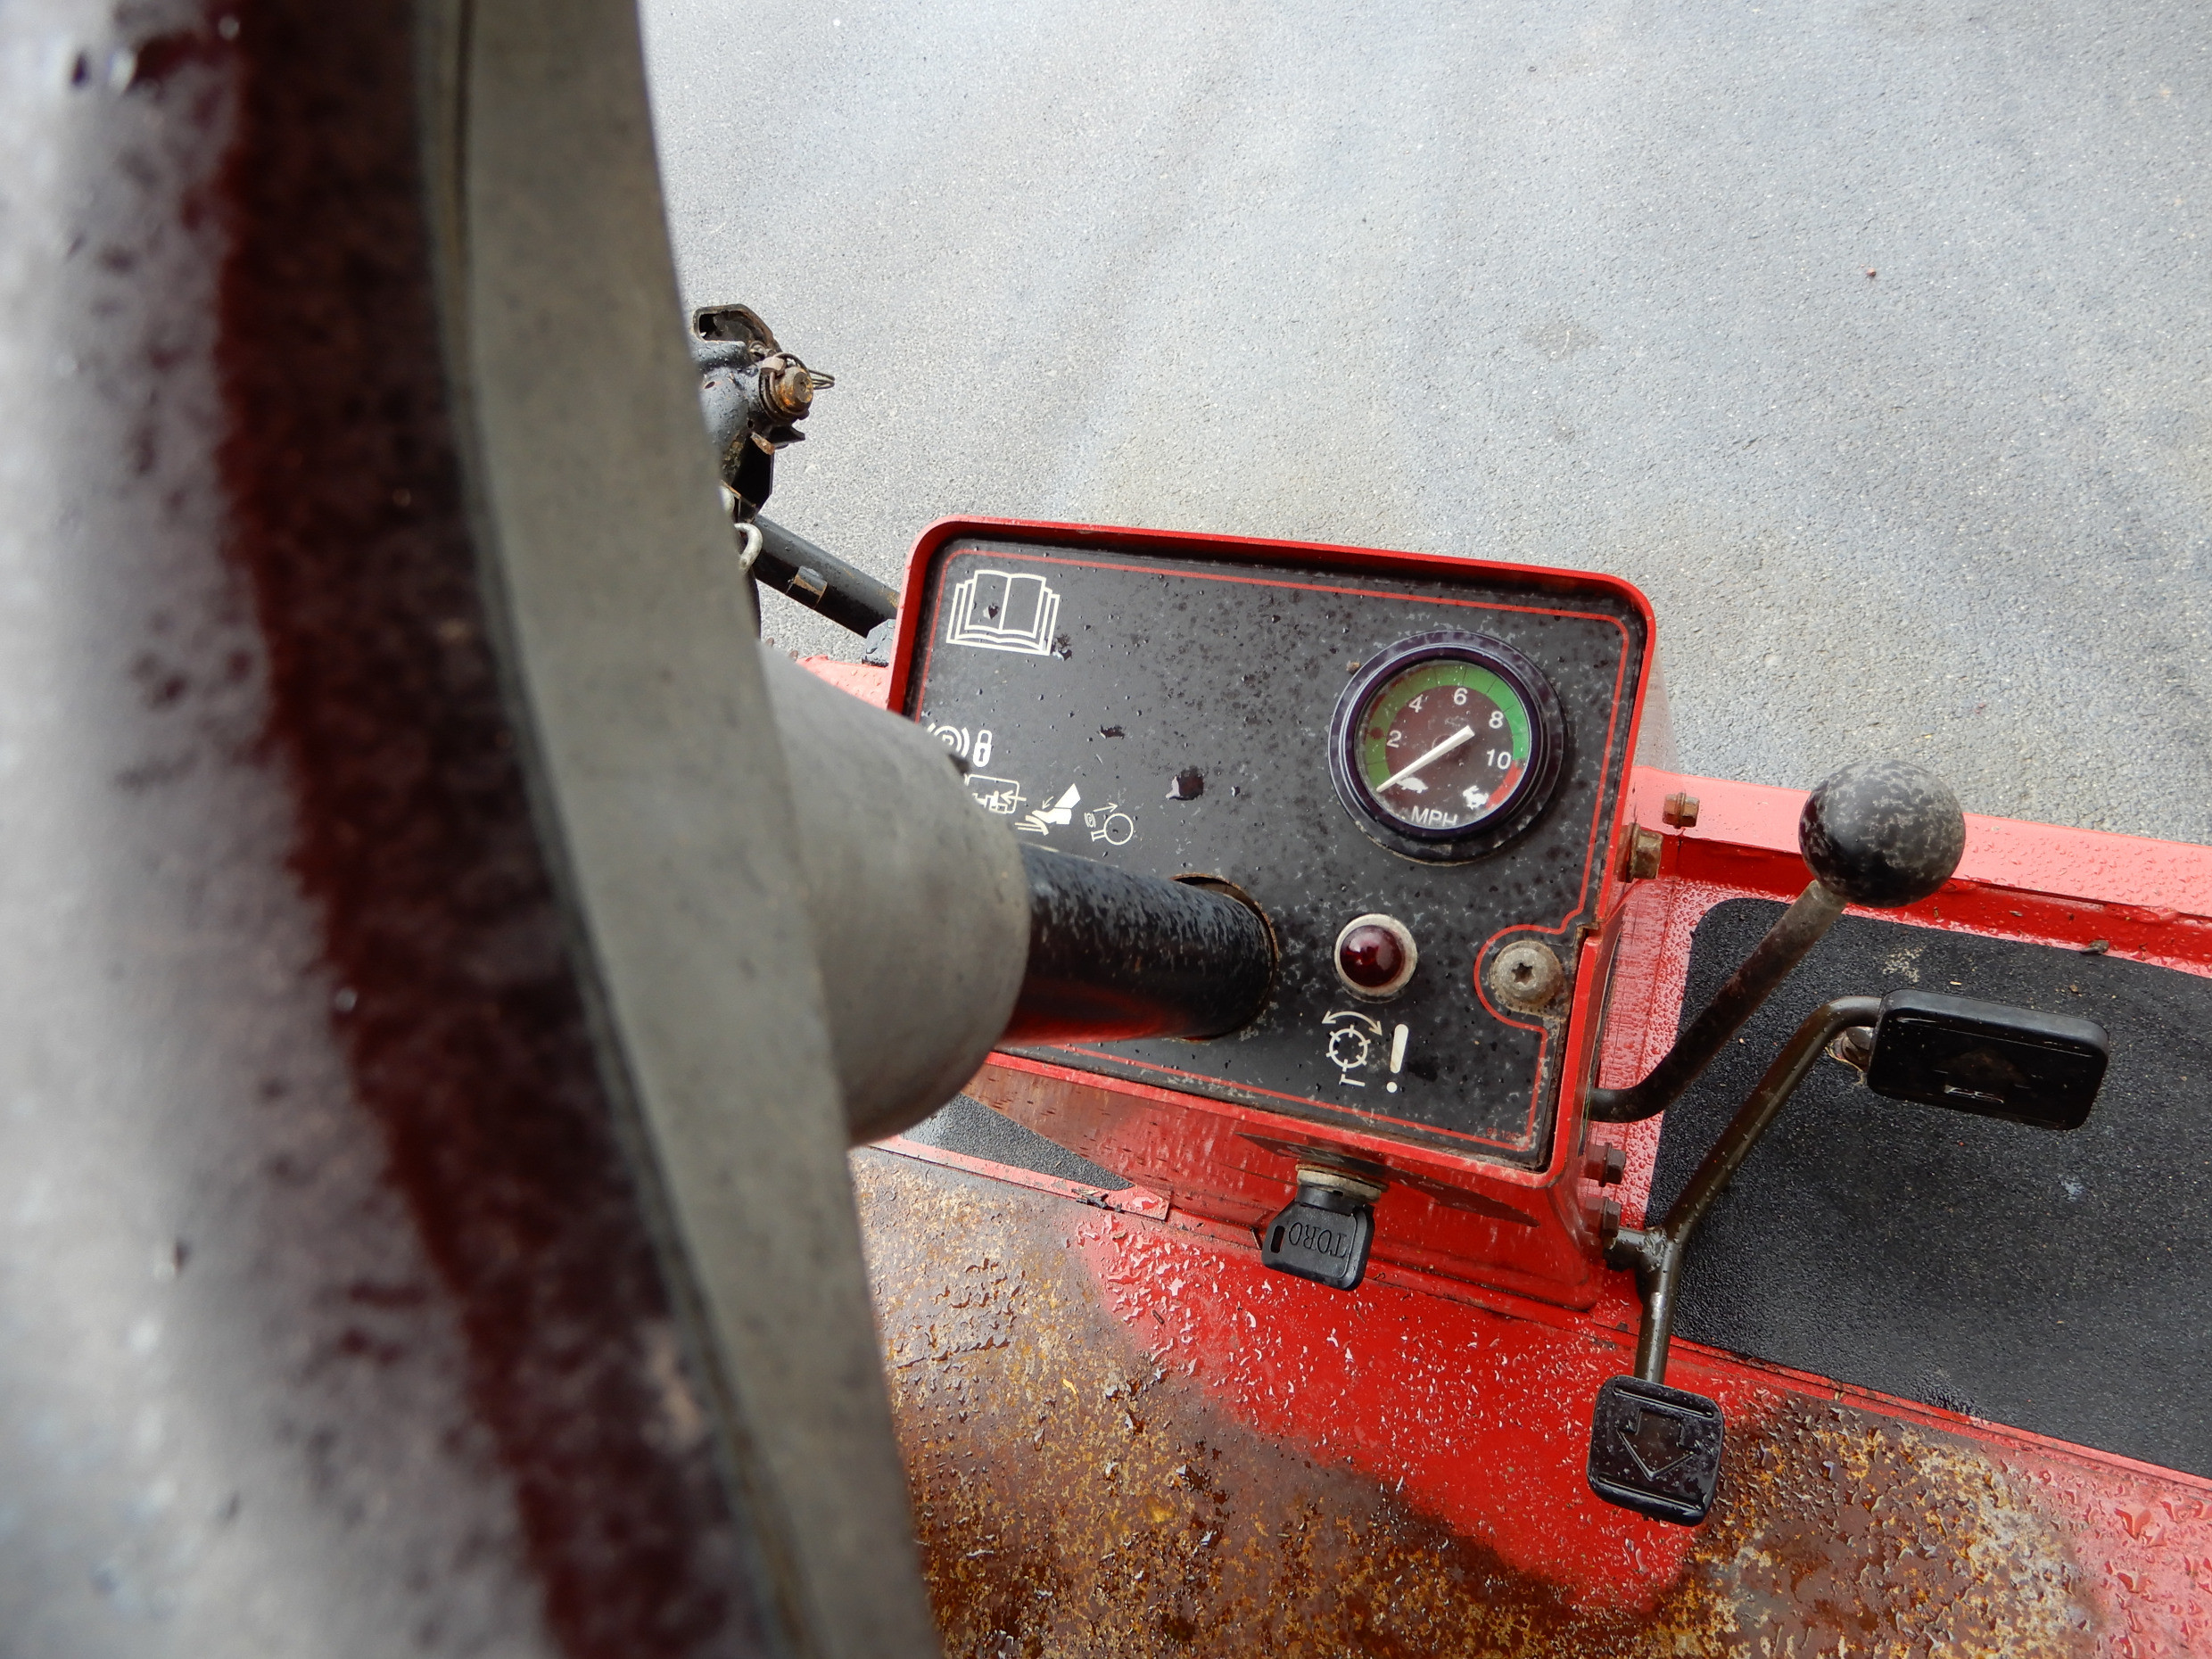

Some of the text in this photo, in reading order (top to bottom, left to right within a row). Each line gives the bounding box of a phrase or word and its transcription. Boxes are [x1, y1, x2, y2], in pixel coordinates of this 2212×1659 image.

[1408, 694, 1424, 714] 4
[1453, 688, 1468, 706] 6
[1488, 712, 1504, 730] 8
[1386, 730, 1402, 748] 2
[1486, 748, 1512, 770] 10
[1411, 805, 1458, 826] MPH
[1288, 1221, 1348, 1259] TORO
